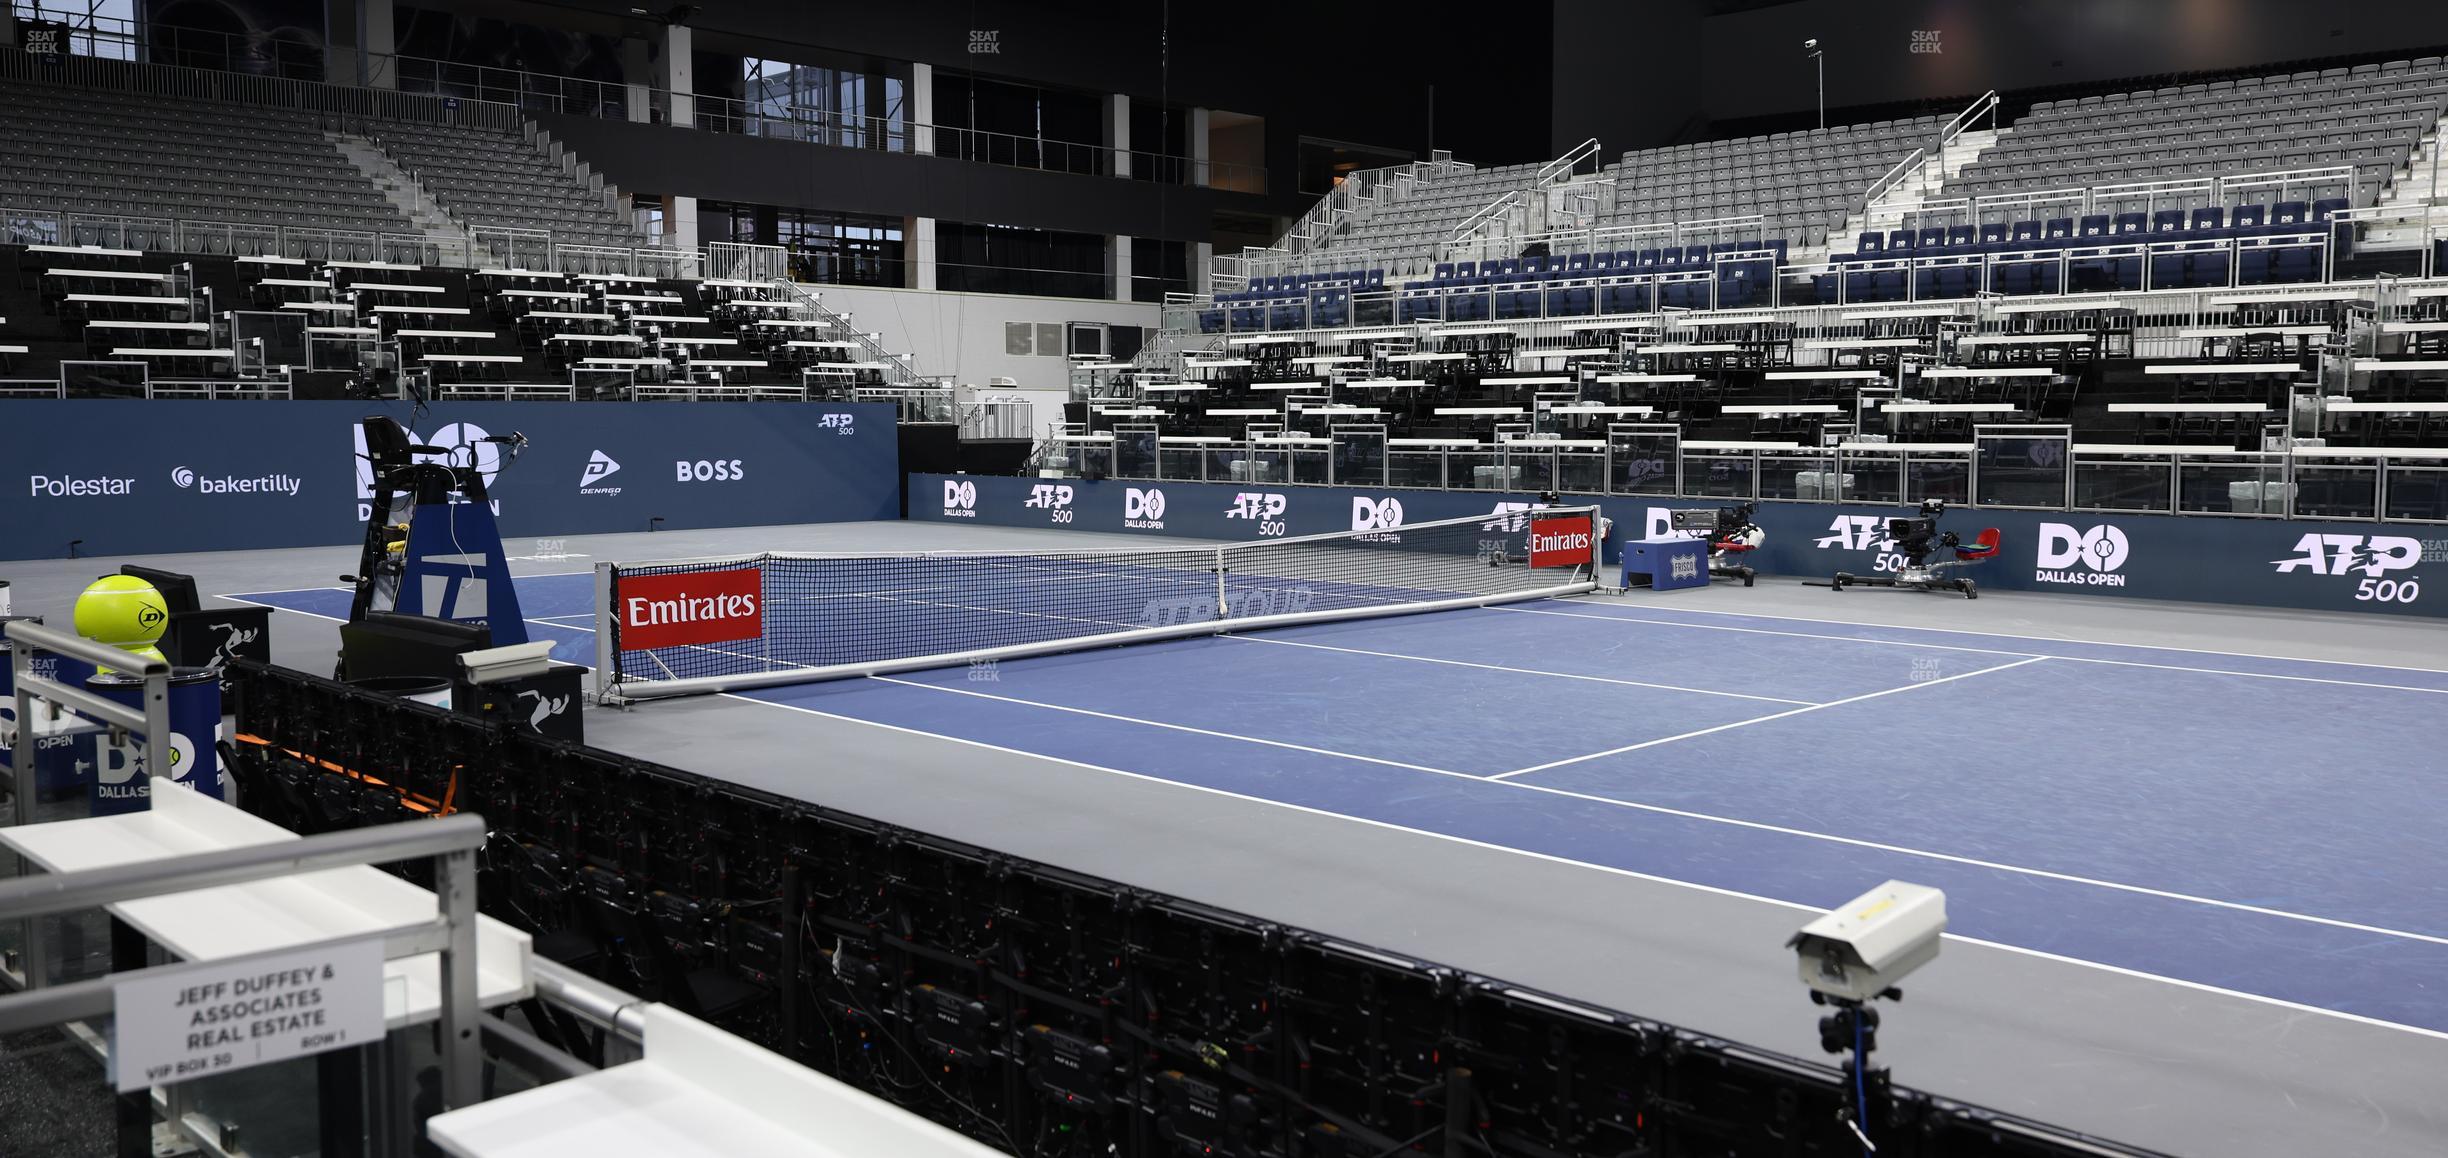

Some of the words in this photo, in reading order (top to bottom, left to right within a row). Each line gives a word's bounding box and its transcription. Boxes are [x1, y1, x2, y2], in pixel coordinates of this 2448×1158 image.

[817, 413, 854, 428] ATP
[838, 427, 854, 435] 500
[677, 459, 744, 482] BOSS
[31, 475, 135, 497] Polestar
[200, 474, 300, 497] bakertilly
[944, 480, 977, 509] DO
[1024, 484, 1074, 509] ATP
[944, 508, 962, 517] DALLAS
[962, 509, 976, 518] OPEN
[1125, 488, 1165, 520] DO
[1224, 492, 1287, 520] ATP
[1352, 496, 1403, 531] DO
[1051, 509, 1073, 523] 500
[1125, 519, 1147, 529] DALLAS
[1147, 520, 1164, 530] OPEN
[1258, 521, 1285, 536] 500
[1532, 531, 1589, 553] Emirates
[2037, 522, 2129, 572] DO
[2269, 533, 2423, 577] ATP
[1674, 561, 1694, 573] FRISCO
[2036, 569, 2086, 585] DALLAS
[2087, 571, 2126, 587] OPEN
[2355, 578, 2420, 603] 500
[627, 592, 756, 628] Emirates
[175, 983, 227, 1007] JEFF
[234, 968, 316, 997] DUFFEY
[322, 963, 335, 981] &
[189, 988, 322, 1027] ASSOCIATES
[187, 1028, 243, 1051] REAL
[251, 1009, 326, 1039] ESTATE
[301, 1032, 337, 1050] ROW
[145, 1064, 172, 1081] VIP
[176, 1057, 210, 1076] BOX
